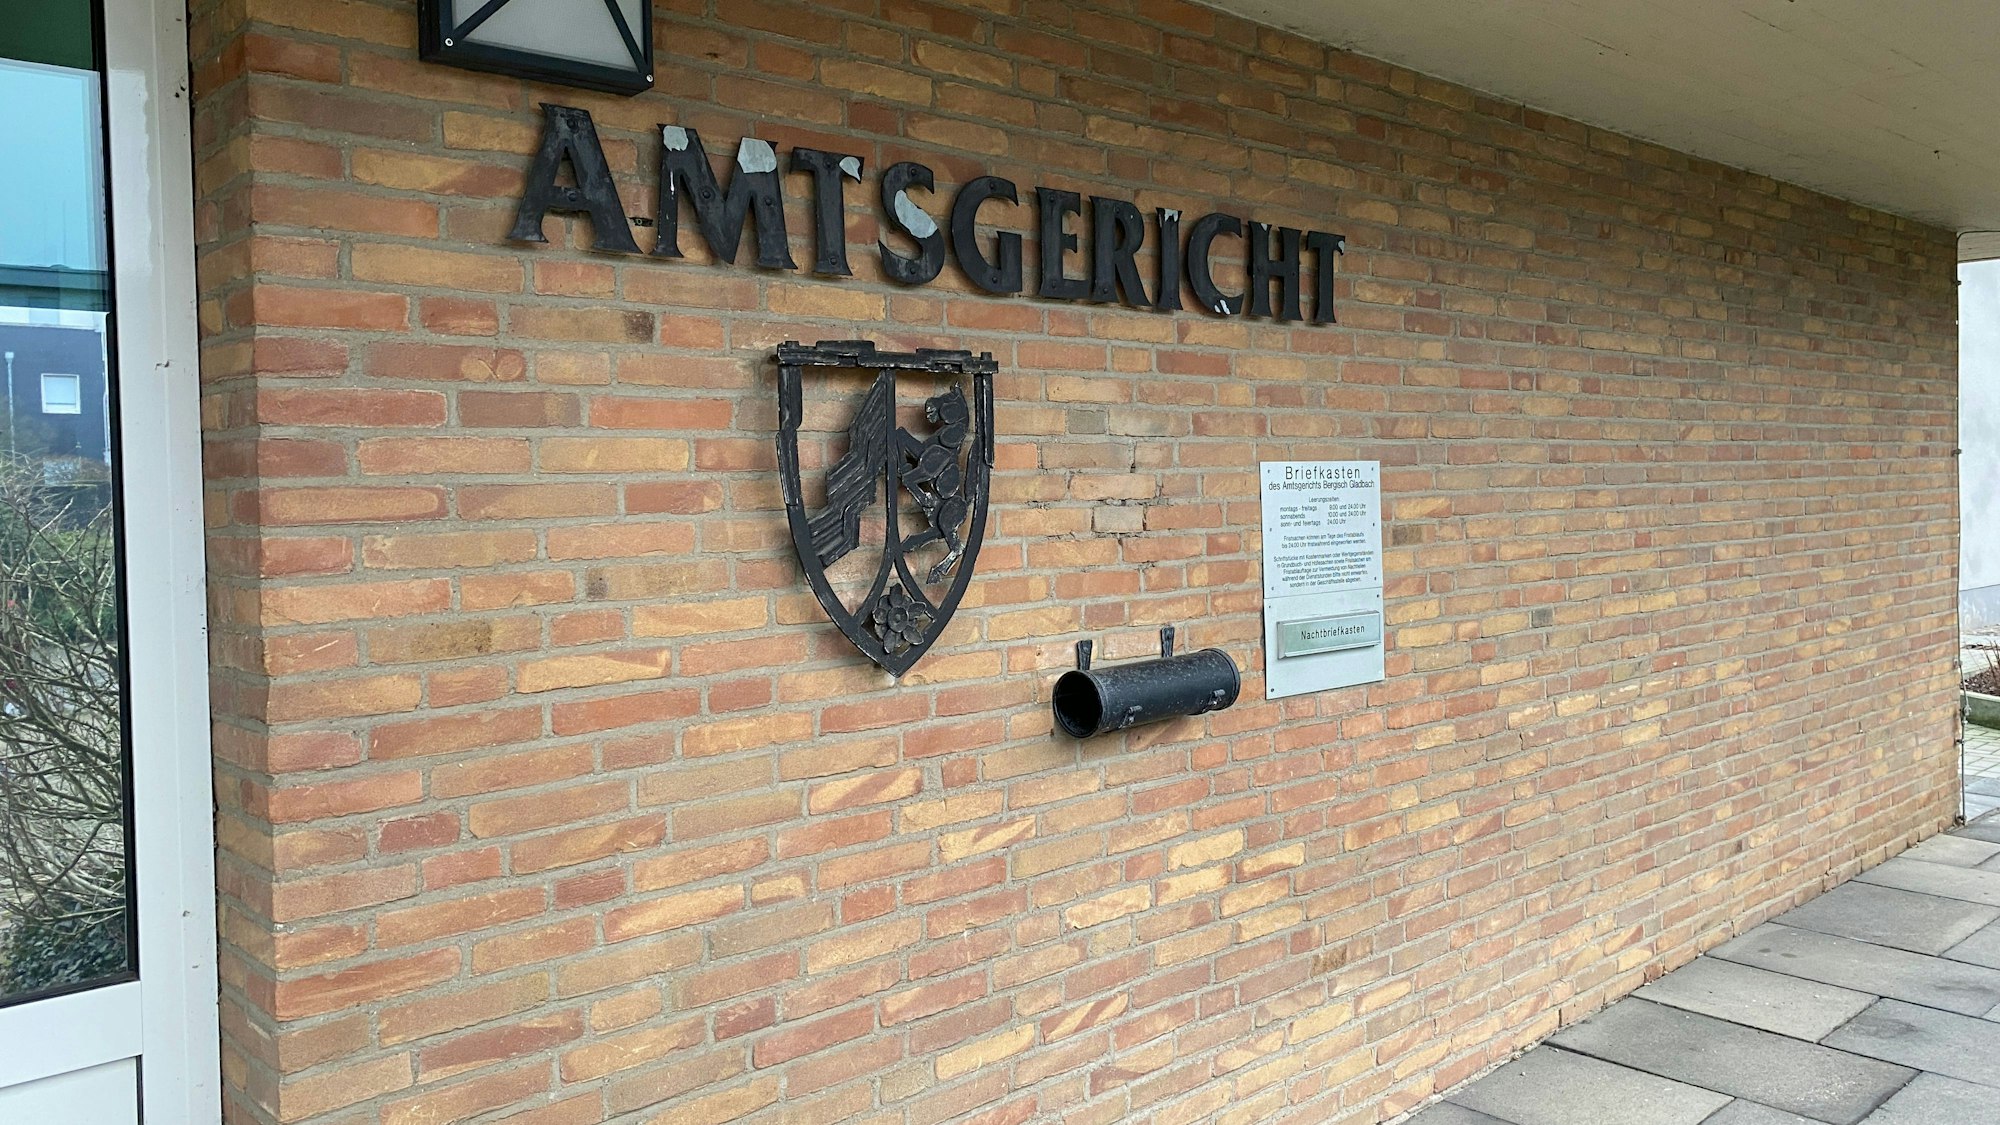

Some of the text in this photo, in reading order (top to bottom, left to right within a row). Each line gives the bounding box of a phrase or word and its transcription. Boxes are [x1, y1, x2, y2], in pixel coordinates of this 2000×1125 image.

[508, 102, 1346, 324] AMTSGERICHT
[1285, 465, 1361, 480] Briefkasten
[1268, 479, 1375, 492] des Amtsgerichts Bergisch Gladbach
[1279, 505, 1298, 513] montags
[1301, 504, 1318, 512] freitags
[1339, 503, 1347, 511] und
[1359, 502, 1367, 510] Uhr
[1280, 512, 1306, 520] sonnabends
[1293, 519, 1302, 527] und
[1302, 519, 1321, 527] feiertags
[1300, 624, 1365, 641] Nachtbriefkasten
